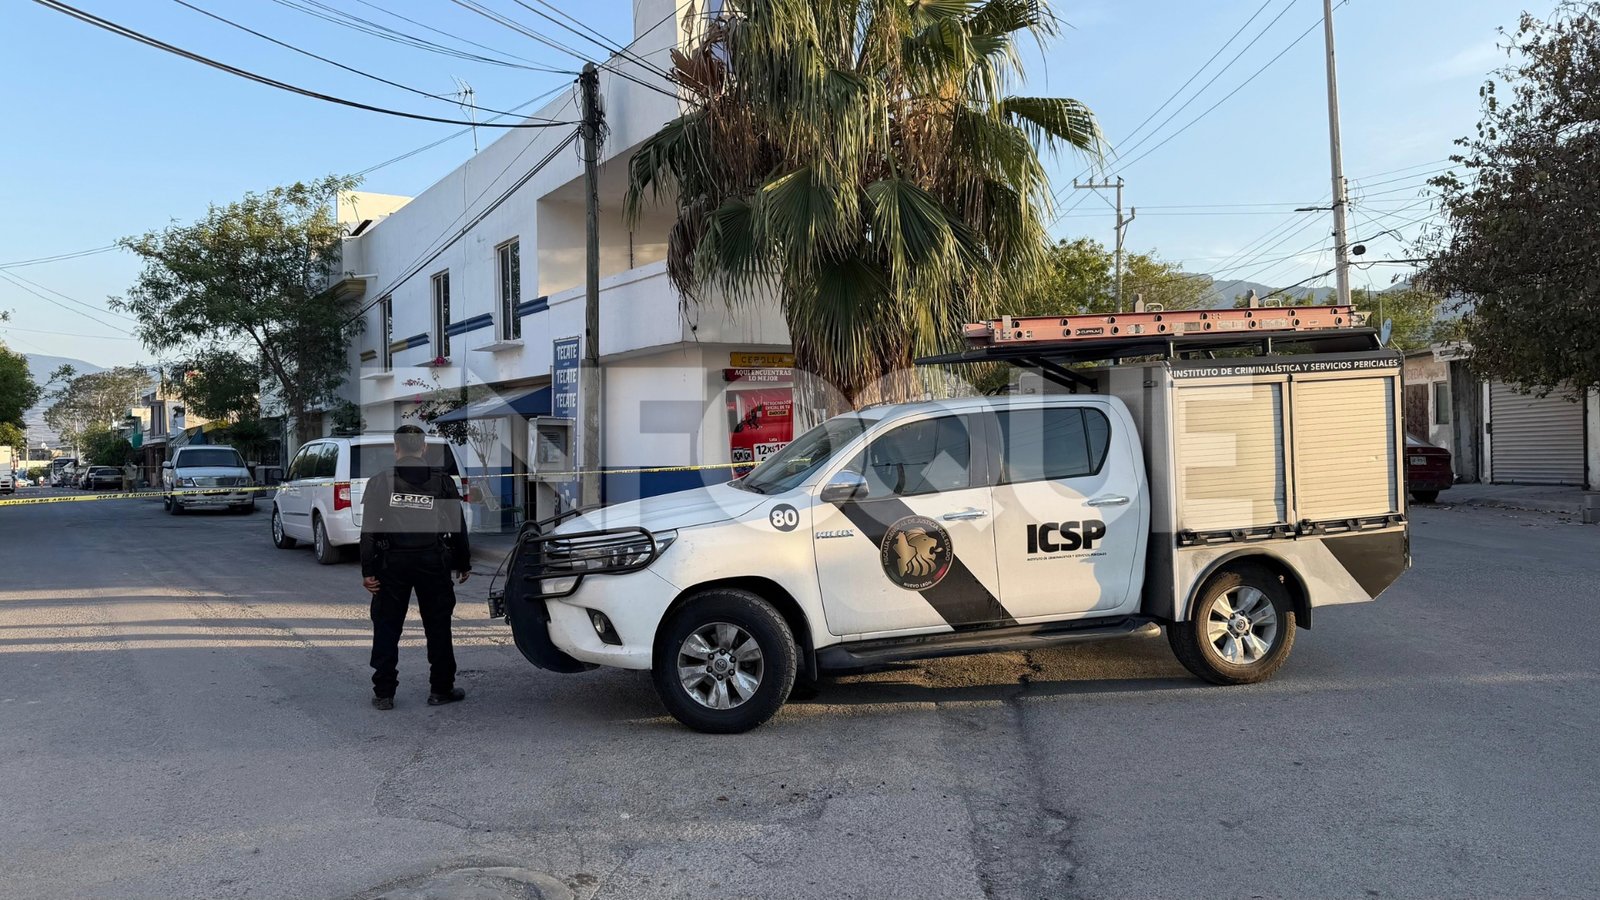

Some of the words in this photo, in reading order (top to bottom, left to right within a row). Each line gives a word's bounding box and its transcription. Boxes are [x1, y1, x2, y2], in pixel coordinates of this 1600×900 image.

[556, 344, 577, 360] TECATE
[556, 368, 577, 384] TECATE
[1174, 368, 1218, 378] INSTITUTO
[1234, 364, 1300, 374] CRIMINALÍSTICA
[1311, 362, 1352, 370] SERVICIOS
[1354, 359, 1398, 368] PERICIALES
[556, 393, 576, 408] TECATE
[772, 509, 797, 527] 80
[1027, 519, 1106, 554] ICSP
